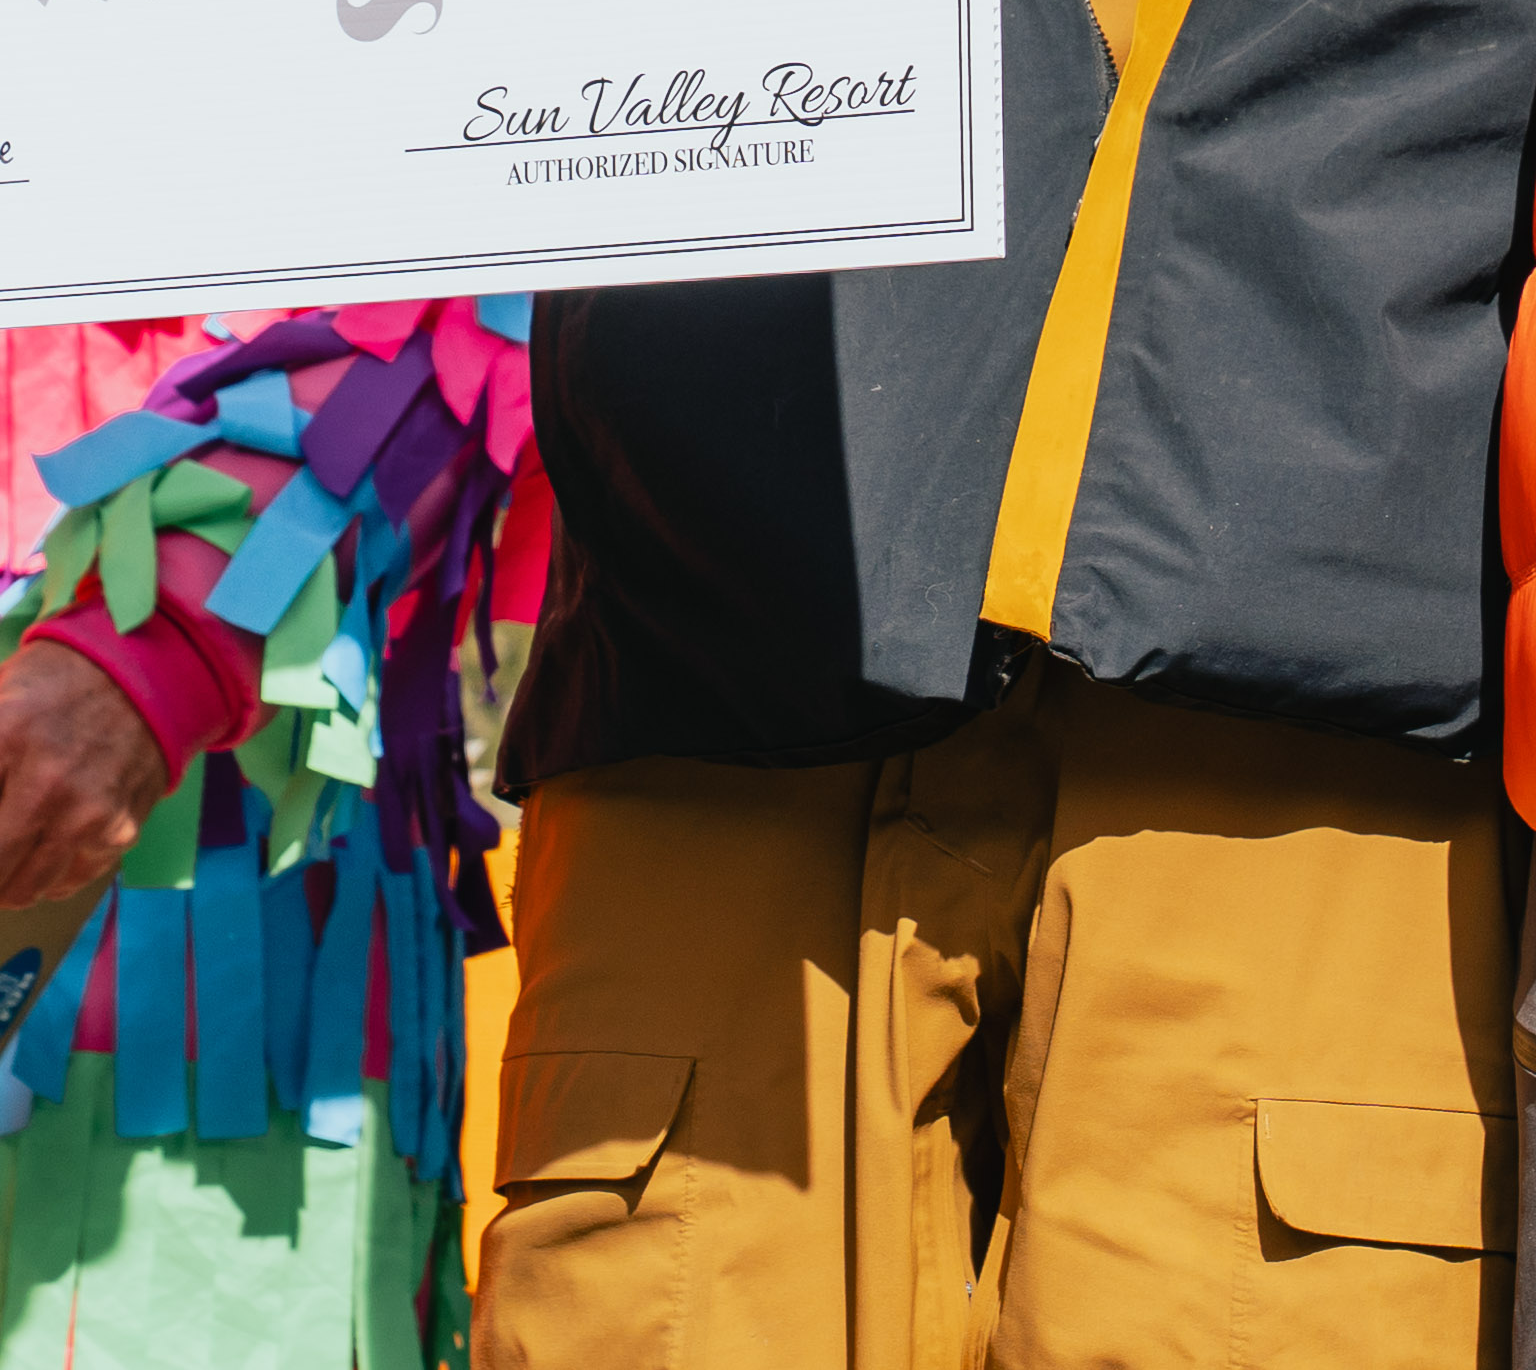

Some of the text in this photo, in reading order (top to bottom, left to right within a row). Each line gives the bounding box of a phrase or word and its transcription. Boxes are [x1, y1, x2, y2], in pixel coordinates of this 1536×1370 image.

[463, 61, 917, 150] Sun Valley Resort
[507, 138, 815, 186] AUTHORIZED SIGNATURE
